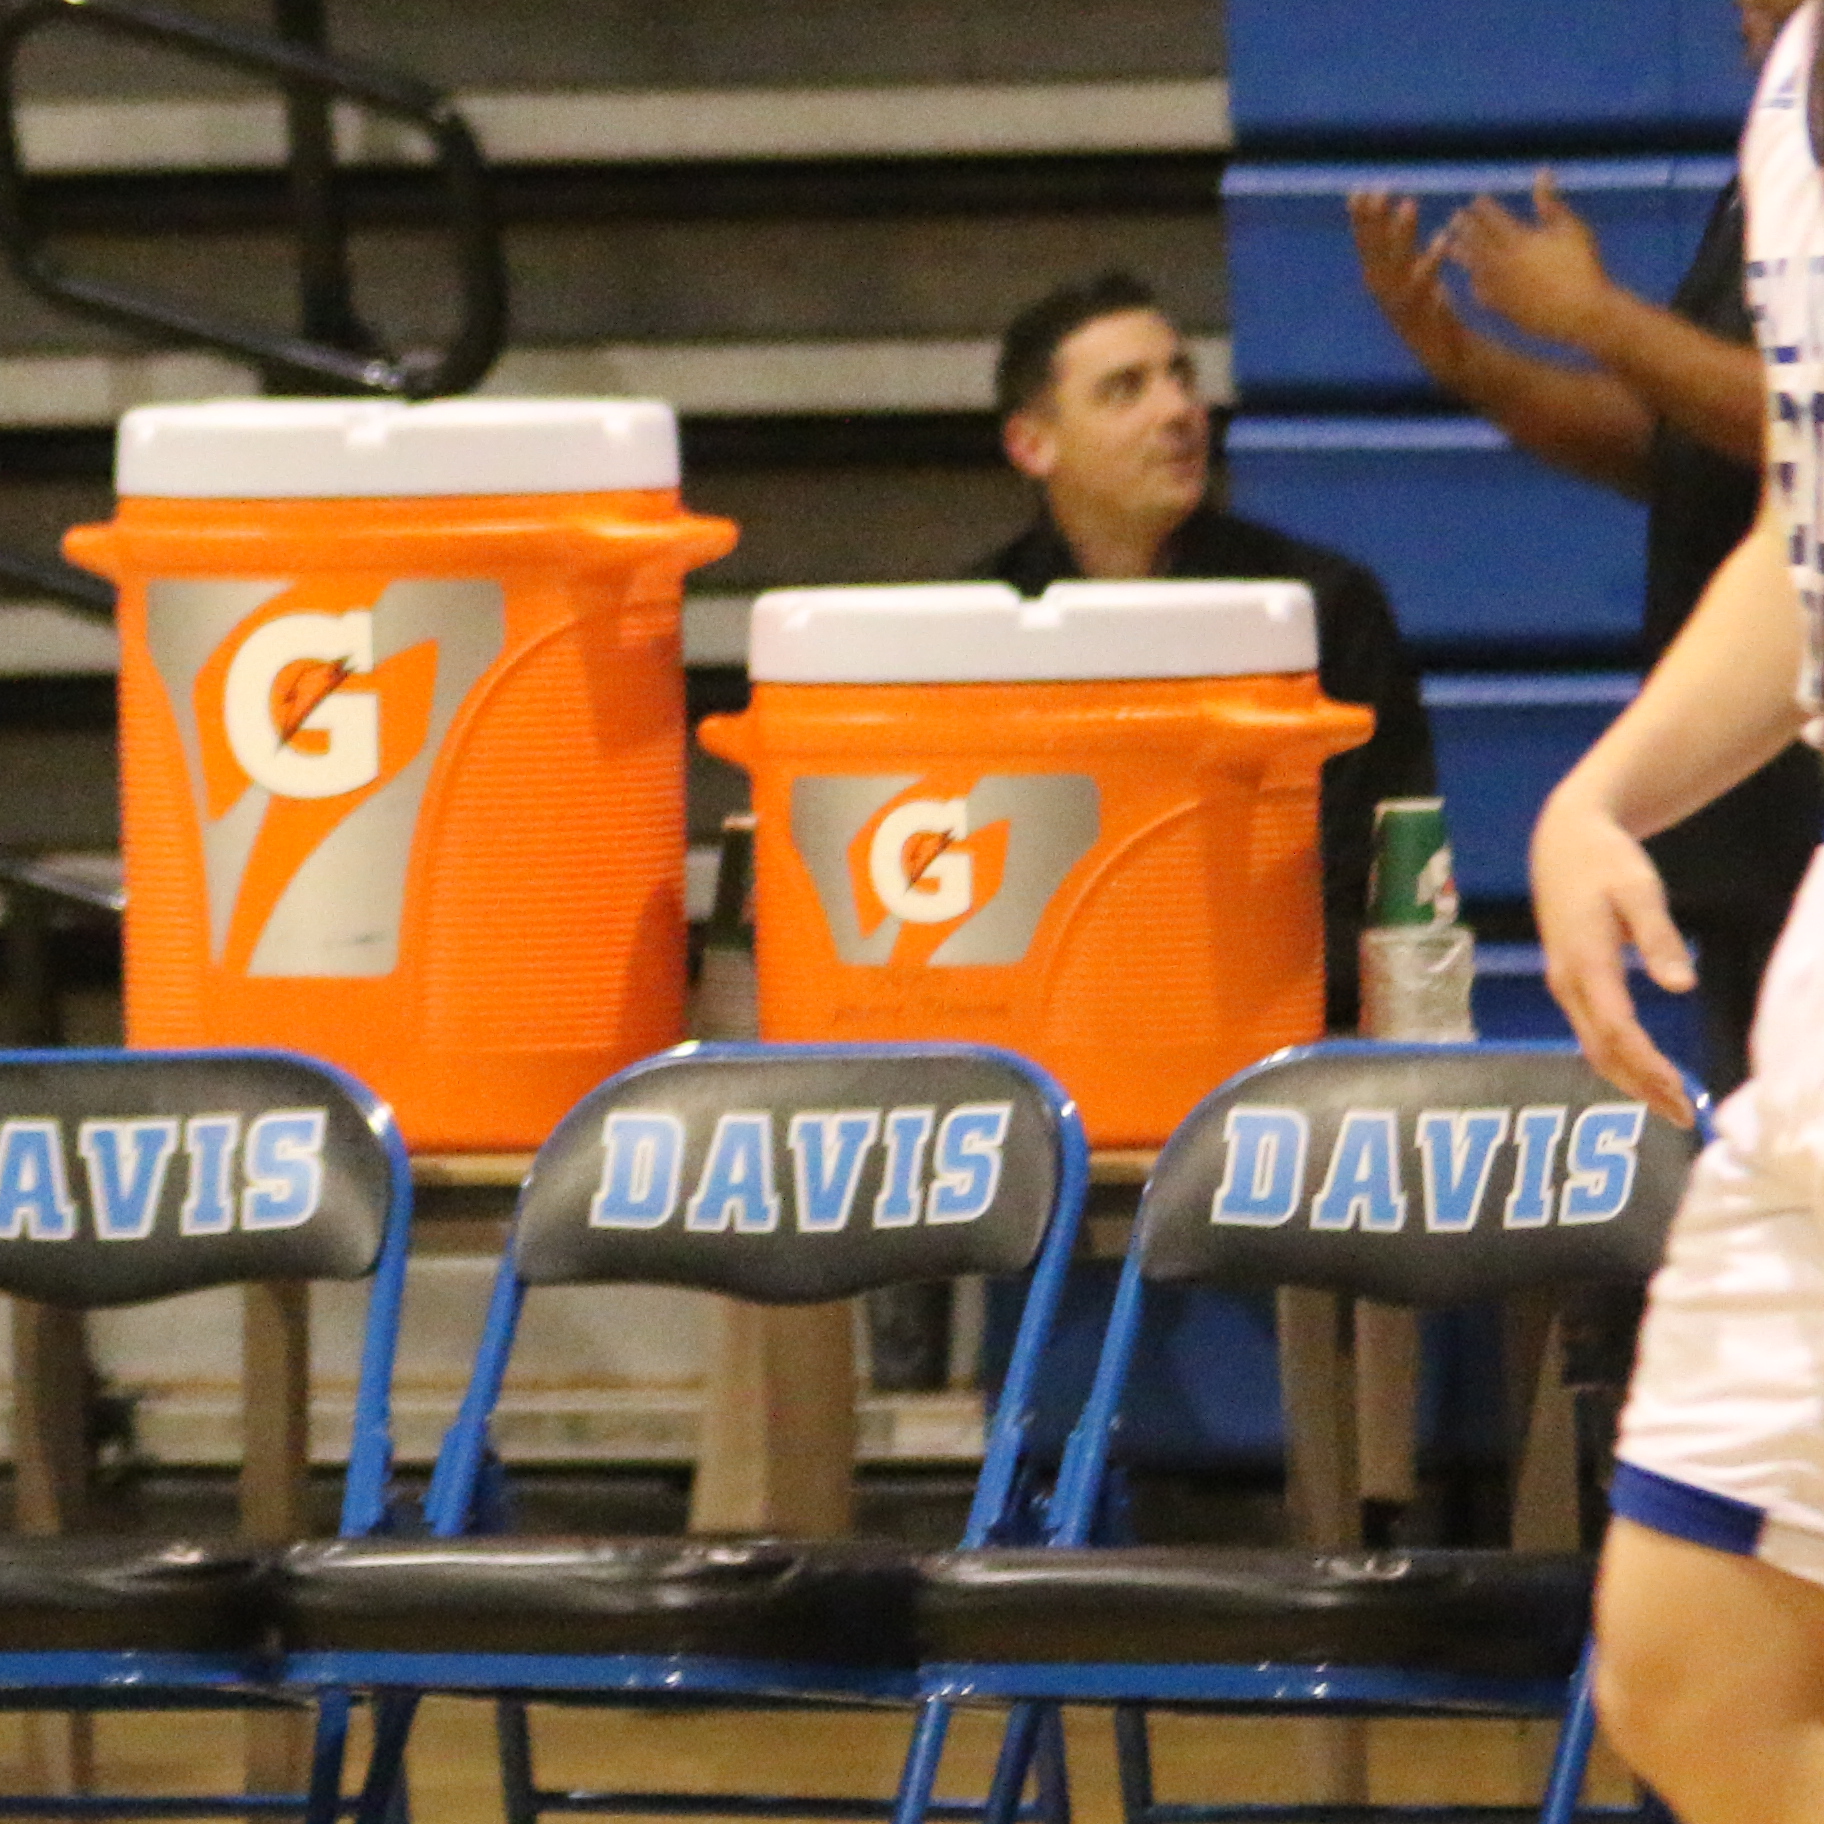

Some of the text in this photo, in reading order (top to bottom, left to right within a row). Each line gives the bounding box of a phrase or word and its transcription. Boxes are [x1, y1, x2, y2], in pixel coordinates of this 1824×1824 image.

[223, 609, 380, 799] G
[869, 798, 975, 924] G
[589, 1102, 1014, 1233] DAVIS
[1210, 1102, 1648, 1233] DAVIS
